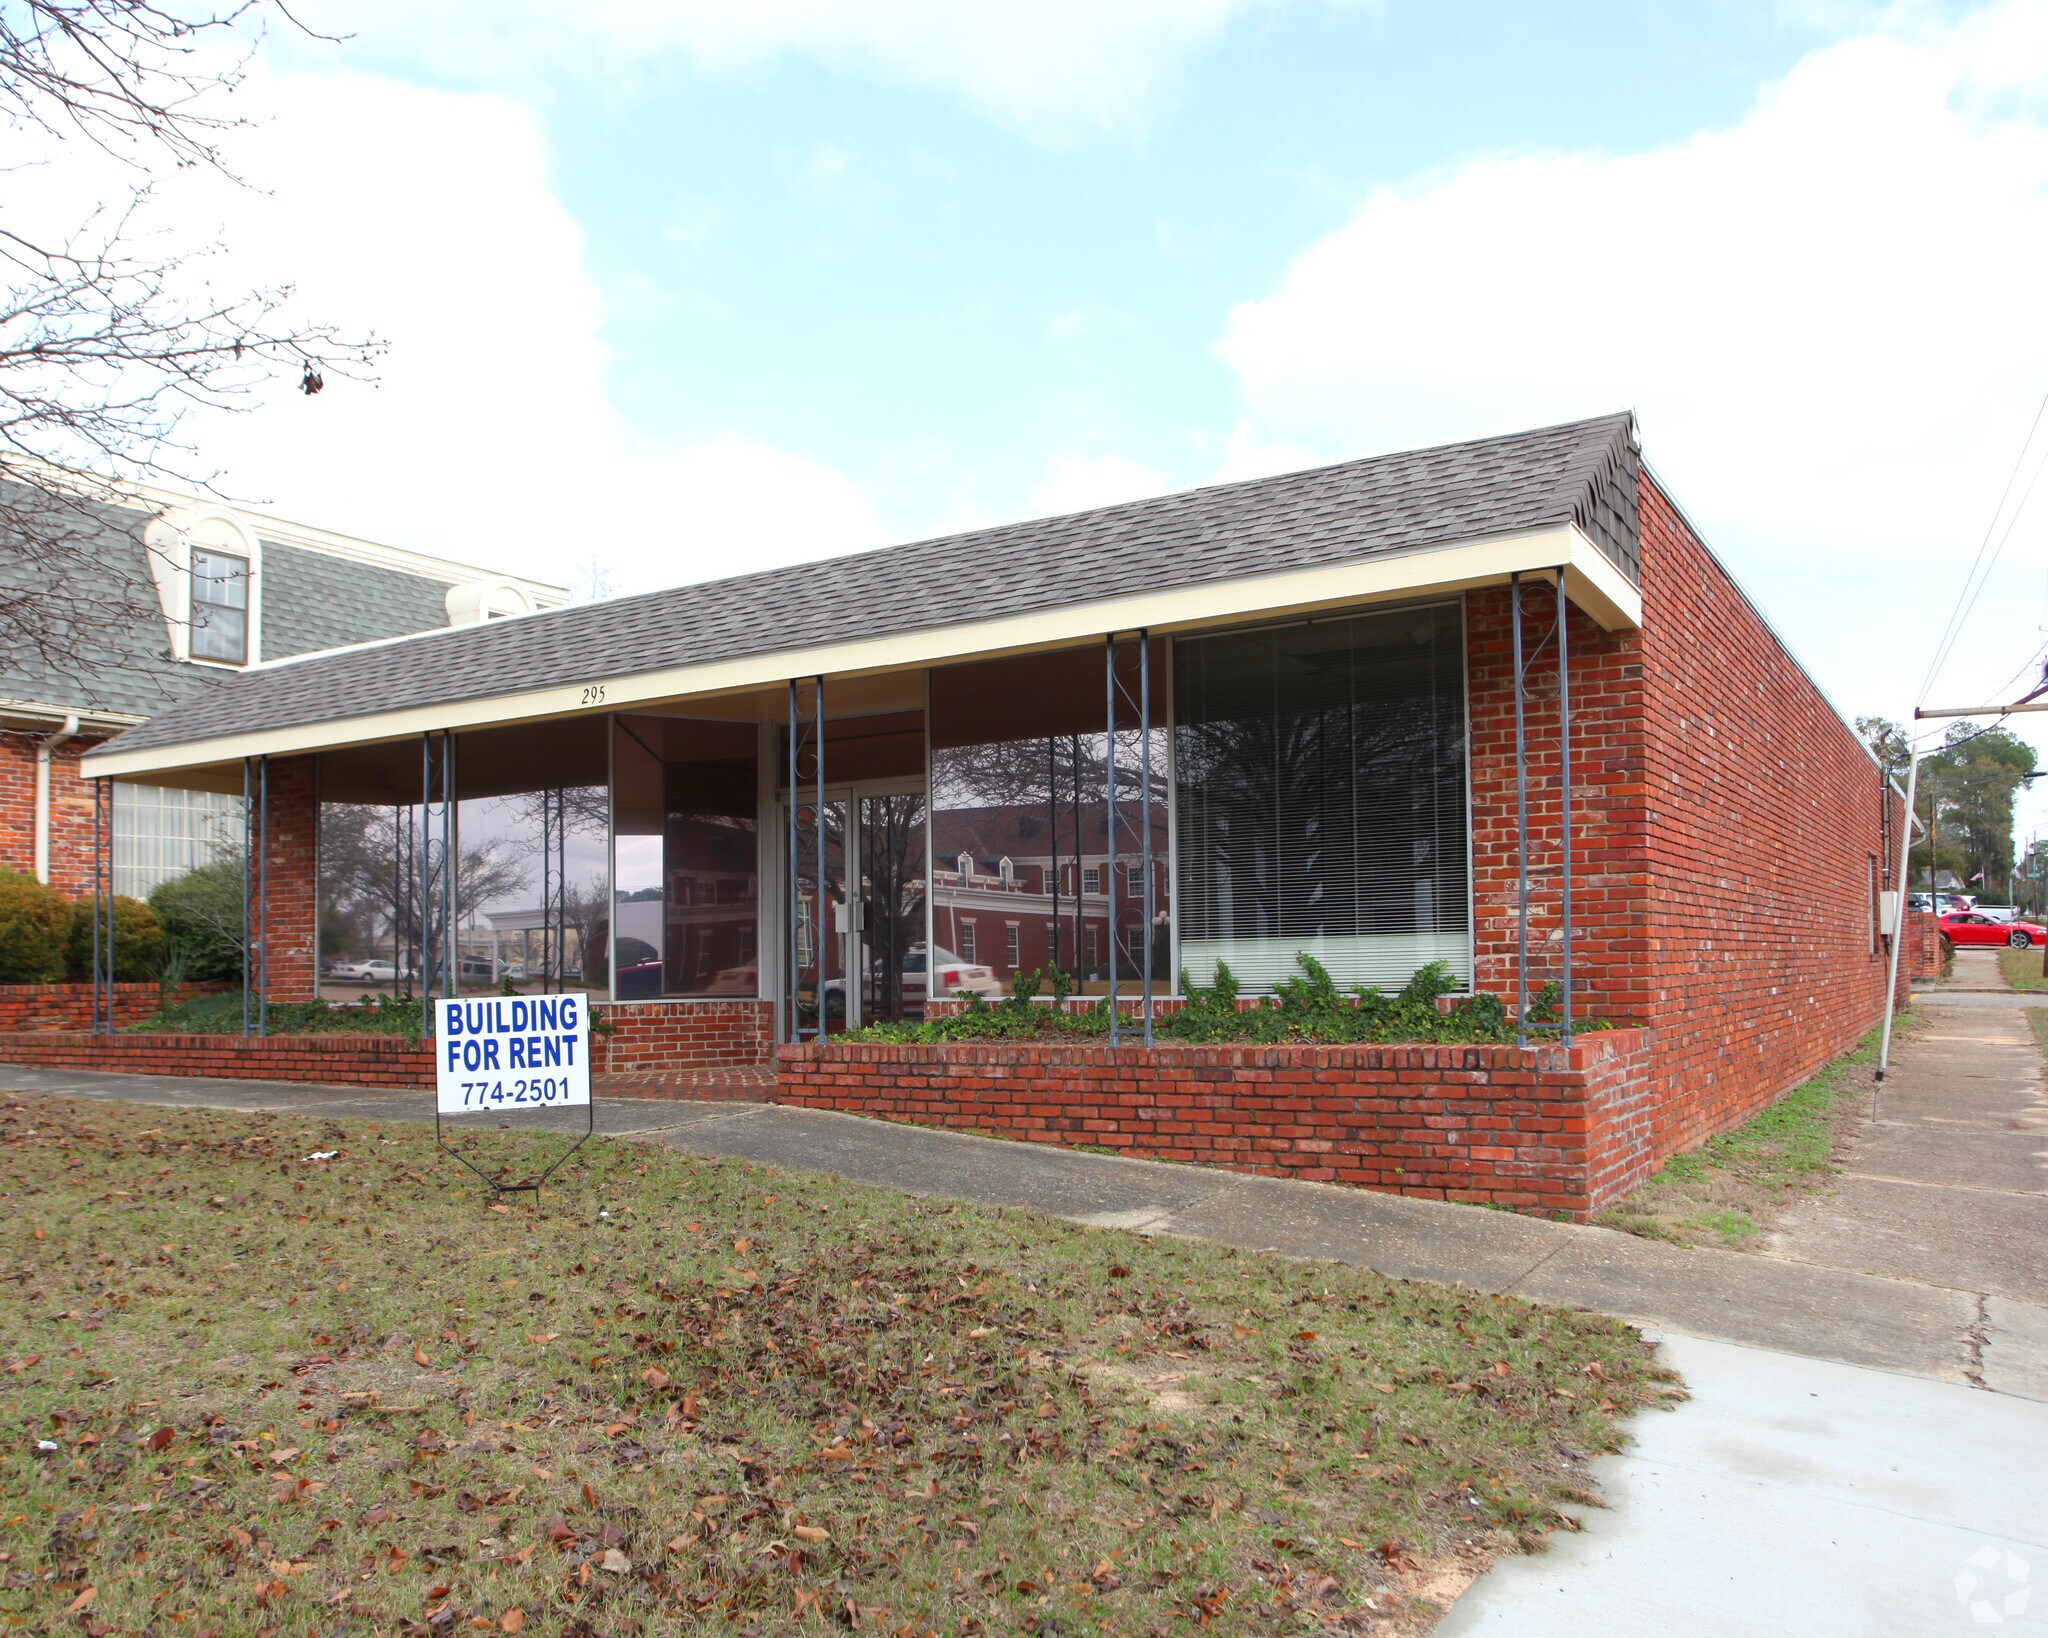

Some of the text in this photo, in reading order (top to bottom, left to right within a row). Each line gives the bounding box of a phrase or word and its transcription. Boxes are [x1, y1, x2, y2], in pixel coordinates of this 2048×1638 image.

[581, 685, 605, 705] 295
[446, 998, 578, 1036] BUILDING
[448, 1034, 578, 1073] FOR RENT
[461, 1077, 568, 1105] 774-2501
